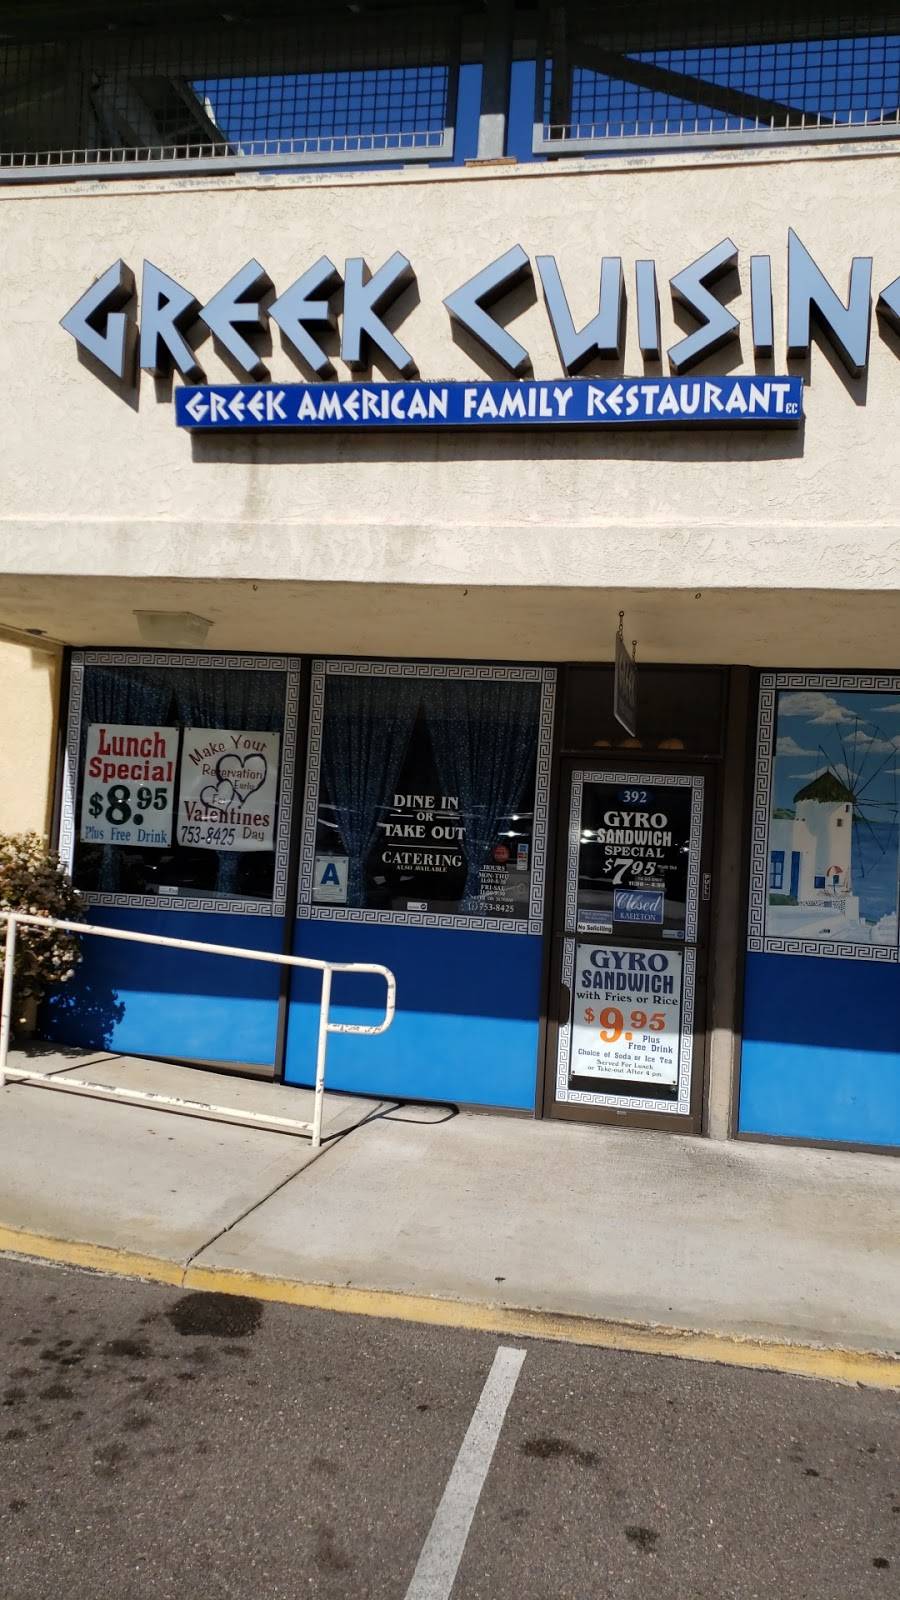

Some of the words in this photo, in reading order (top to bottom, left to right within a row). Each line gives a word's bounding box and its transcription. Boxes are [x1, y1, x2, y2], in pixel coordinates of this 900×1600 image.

[60, 250, 415, 379] GREEK
[185, 389, 287, 423] GREEK
[297, 388, 448, 421] AMERICAN
[464, 385, 573, 418] FAMILY
[587, 382, 790, 416] RESTAURANT
[97, 729, 166, 758] Lunch
[188, 742, 225, 766] Make
[230, 734, 268, 752] Your
[88, 756, 173, 783] Special
[202, 763, 264, 781] Reervation
[393, 794, 435, 809] DINE
[441, 796, 459, 810] IN
[623, 790, 647, 803] 392
[184, 800, 270, 827] Valentines
[416, 811, 434, 822] OR
[603, 811, 668, 829] GYRO
[85, 826, 104, 840] Plus
[111, 827, 131, 842] Free
[137, 829, 168, 843] Drink
[181, 826, 236, 846] 753-8425
[242, 827, 265, 842] Day
[383, 823, 426, 838] TAKE
[431, 826, 467, 840] OUT
[597, 828, 672, 847] SANDWICH
[381, 851, 463, 867] CATERING
[604, 846, 665, 858] SPECIAL
[320, 862, 340, 884] A
[615, 891, 663, 912] Closed
[589, 949, 669, 973] GYRO
[581, 969, 674, 994] SANDWICH
[576, 990, 601, 1000] with
[605, 991, 632, 1003] Fries
[636, 996, 648, 1004] or
[652, 994, 679, 1006] Rice
[628, 1042, 647, 1051] Free
[651, 1044, 673, 1054] Drink
[643, 1035, 661, 1044] Plus
[578, 1048, 600, 1057] Choice
[614, 1052, 632, 1060] Soda
[645, 1055, 655, 1063] Ice
[659, 1056, 673, 1064] Tea
